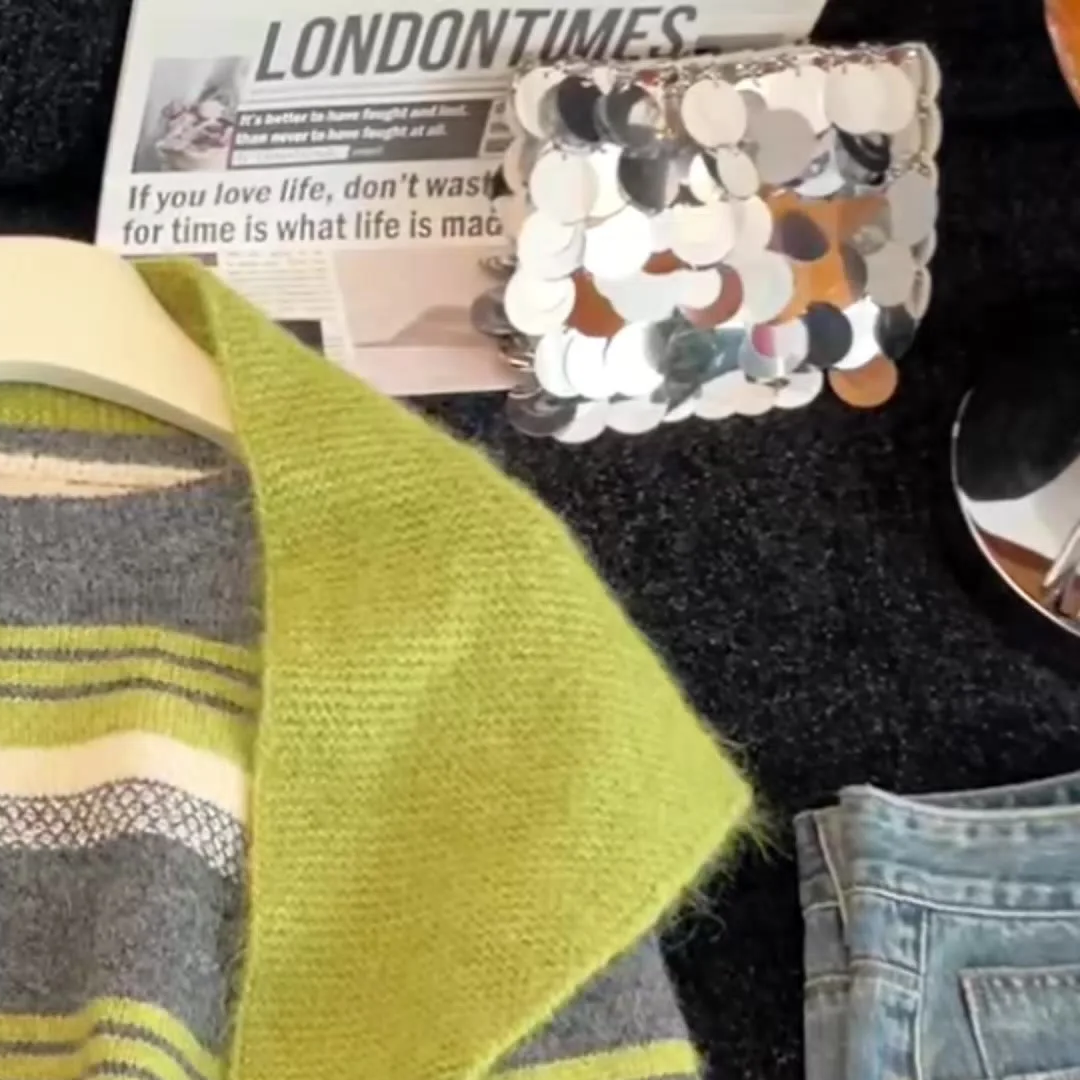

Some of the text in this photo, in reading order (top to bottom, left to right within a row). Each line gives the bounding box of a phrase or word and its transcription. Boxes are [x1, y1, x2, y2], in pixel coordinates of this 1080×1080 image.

[128, 183, 151, 212] If
[154, 188, 207, 214] you
[213, 181, 272, 206] love
[279, 175, 333, 205] life,
[425, 169, 494, 198] wast
[122, 209, 504, 246] for time is what life is mad
